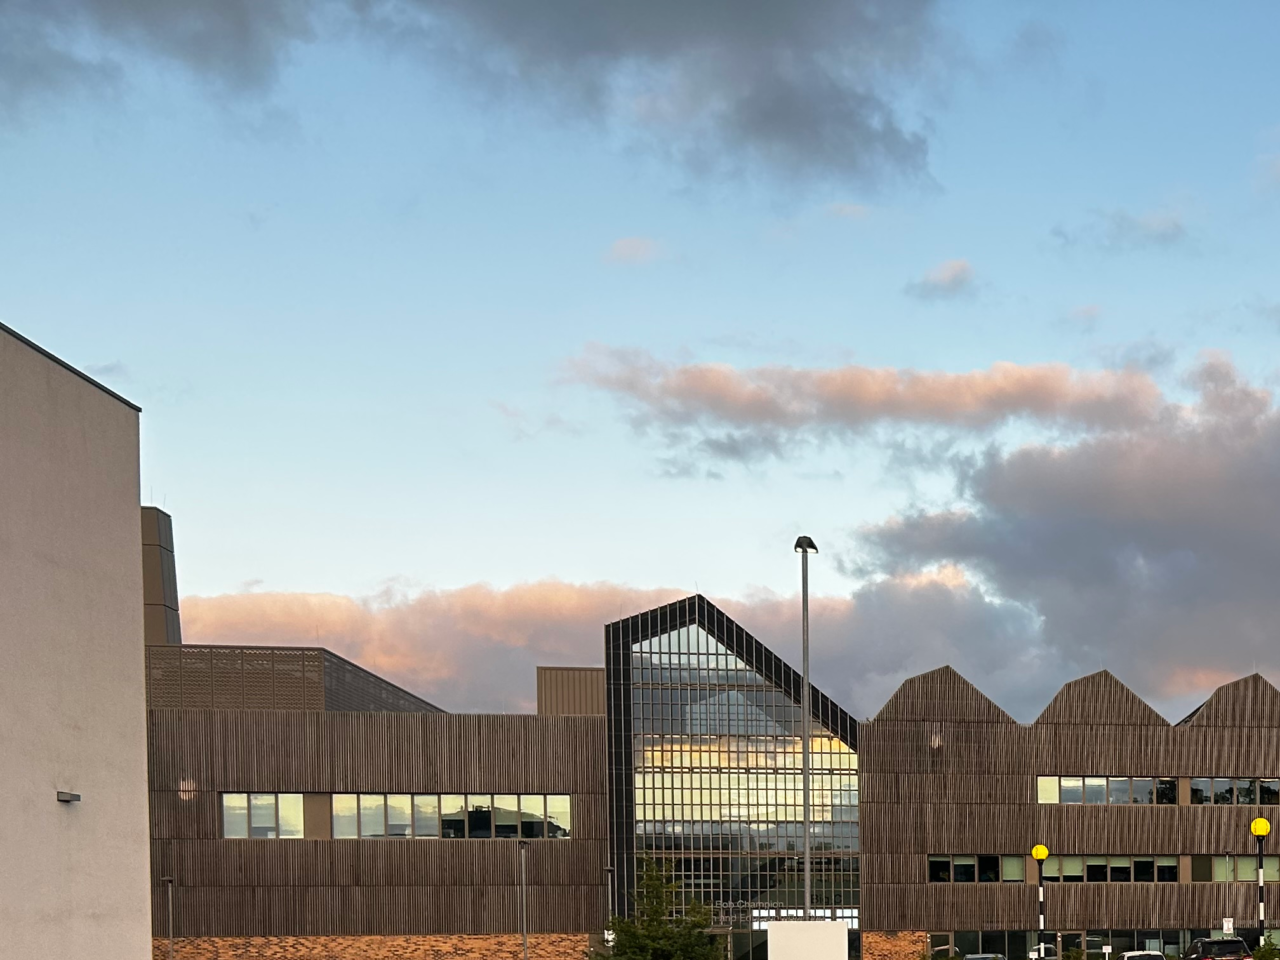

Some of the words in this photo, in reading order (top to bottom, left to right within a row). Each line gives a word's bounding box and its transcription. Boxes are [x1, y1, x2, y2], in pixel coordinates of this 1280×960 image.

[715, 900, 735, 908] Bob
[737, 899, 784, 910] Champion
[811, 894, 830, 906] Big
[834, 894, 843, 904] C
